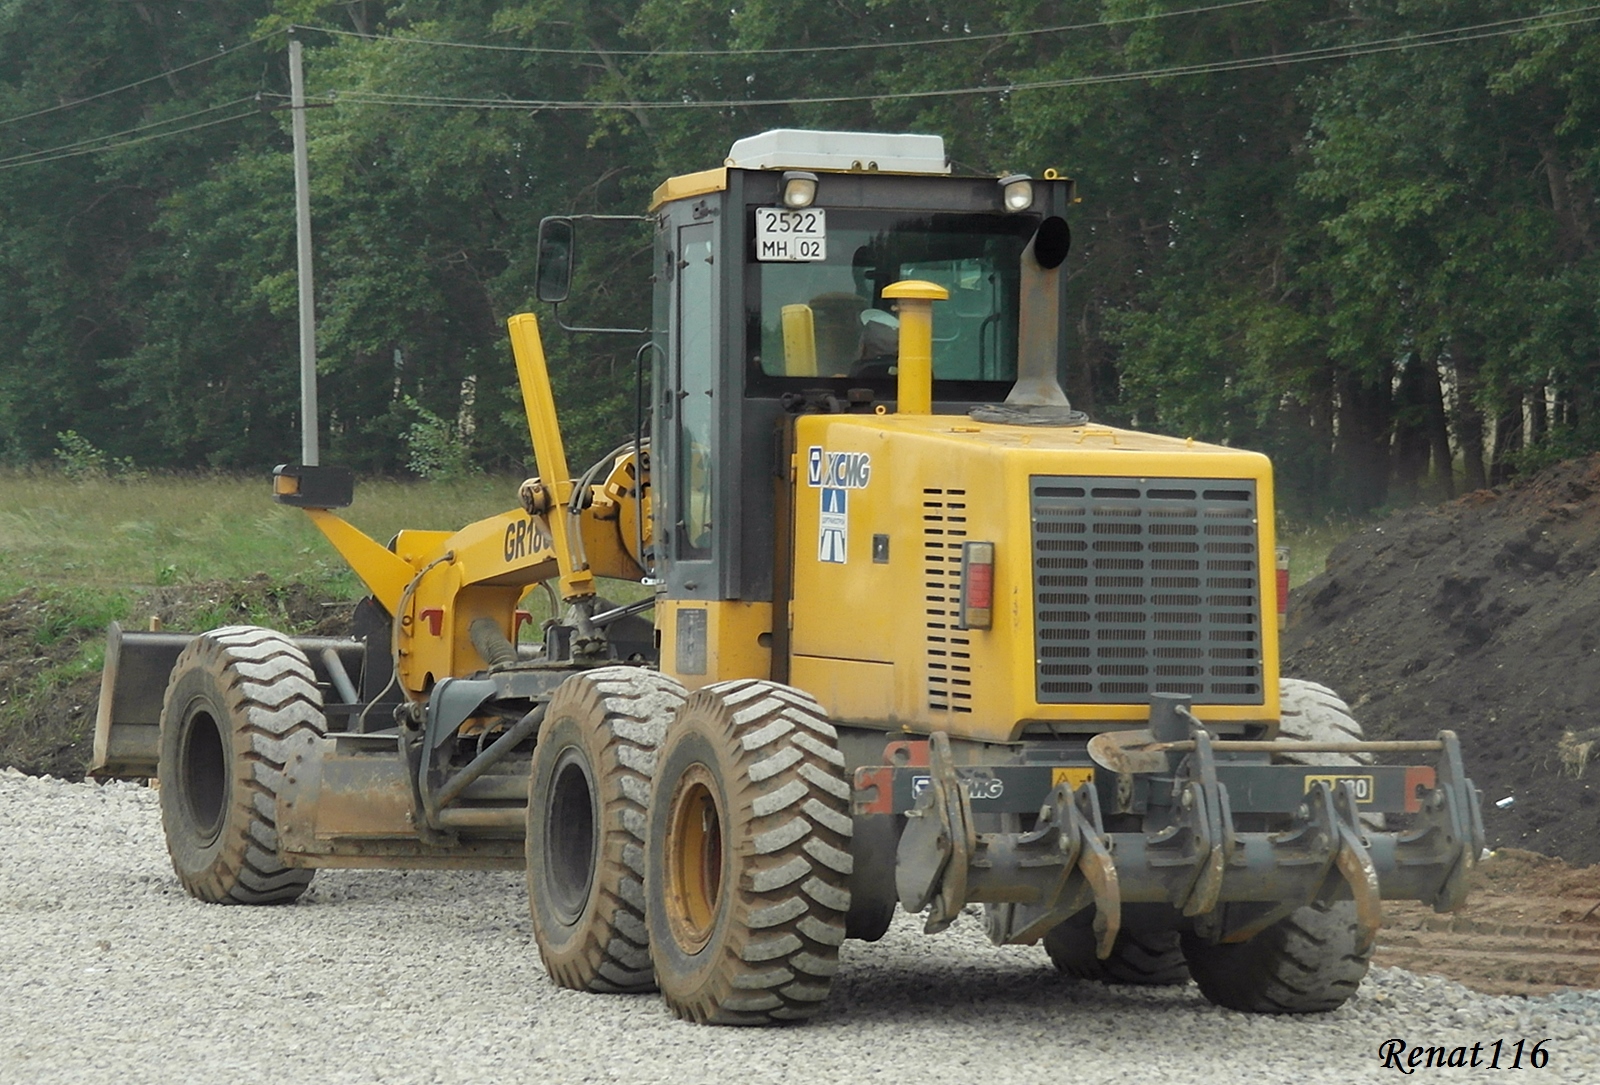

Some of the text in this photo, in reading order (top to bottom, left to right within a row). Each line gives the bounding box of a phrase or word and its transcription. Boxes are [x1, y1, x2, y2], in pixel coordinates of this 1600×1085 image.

[766, 213, 816, 233] 2522
[801, 241, 820, 257] 02
[825, 453, 870, 488] XCMG
